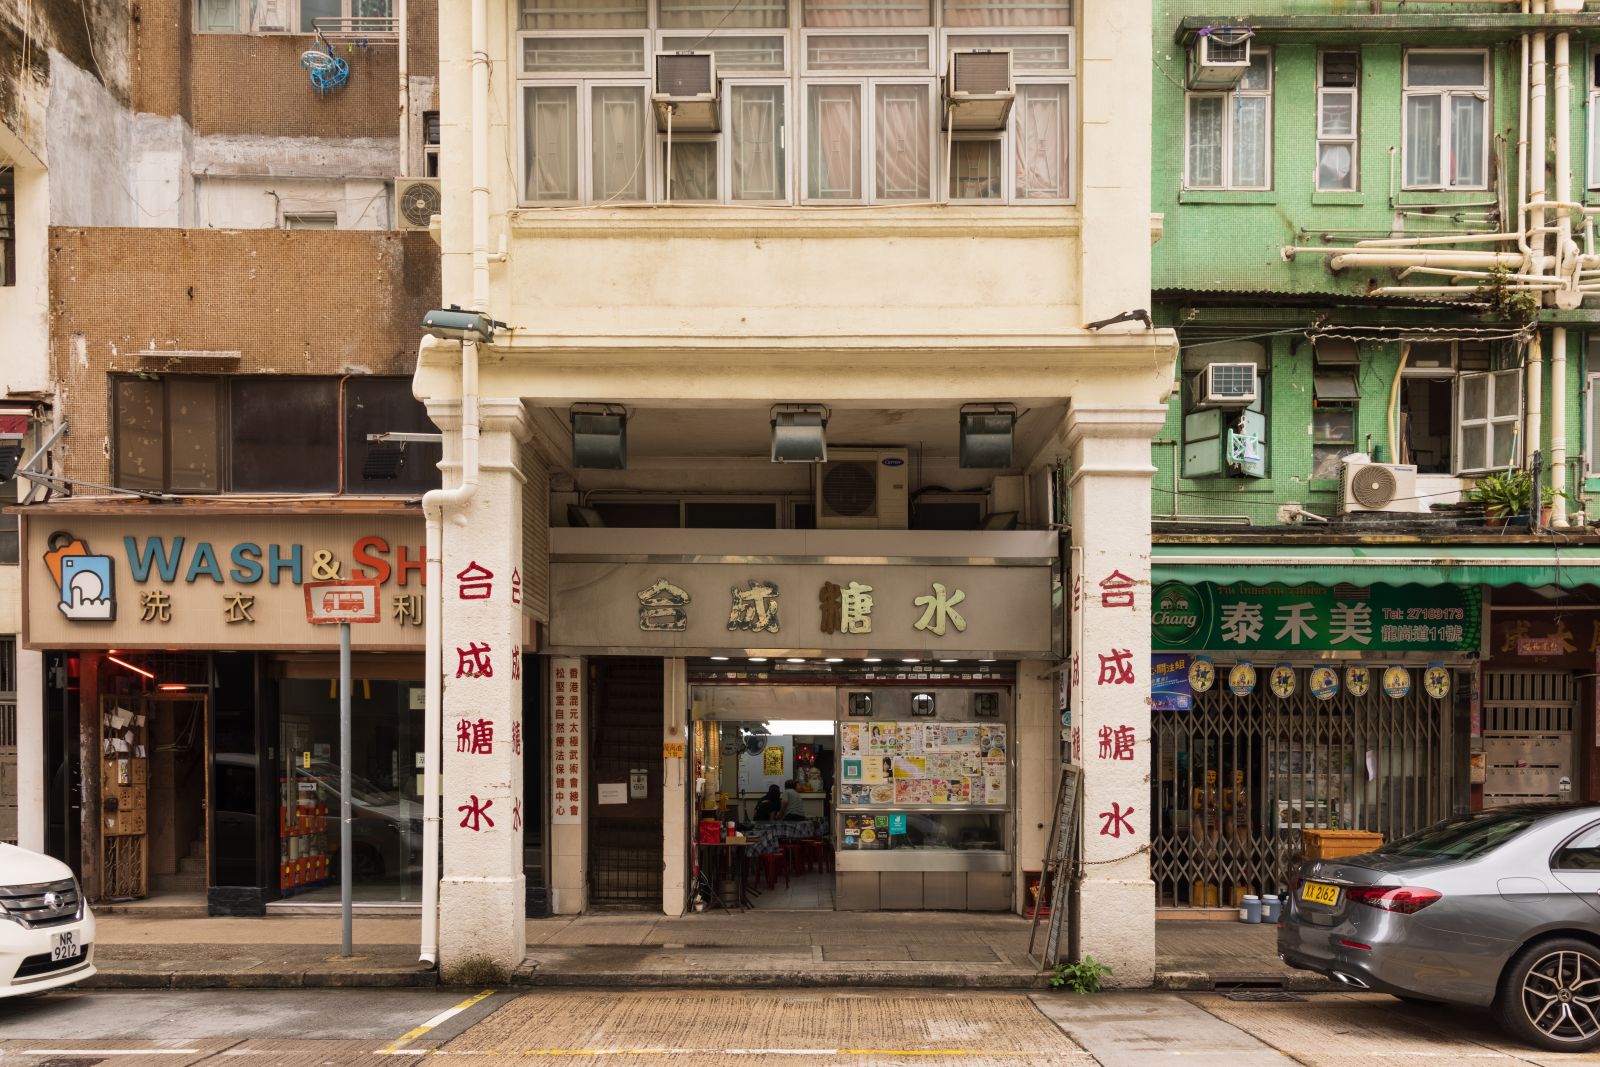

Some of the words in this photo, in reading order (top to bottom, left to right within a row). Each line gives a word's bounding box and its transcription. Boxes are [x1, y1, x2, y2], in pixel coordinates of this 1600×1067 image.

[123, 535, 303, 585] WASH
[311, 549, 343, 581] &
[140, 590, 423, 624] 洗衣利
[637, 577, 967, 636] 合成糖水
[1151, 610, 1197, 628] Chang
[1220, 601, 1373, 646] 泰禾美
[1406, 607, 1464, 620] 27183173
[456, 561, 495, 832] 合成糖水
[1098, 569, 1135, 839] 合成糖水
[1316, 886, 1336, 902] 2162
[55, 944, 77, 959] 9212
[59, 932, 73, 945] NR
